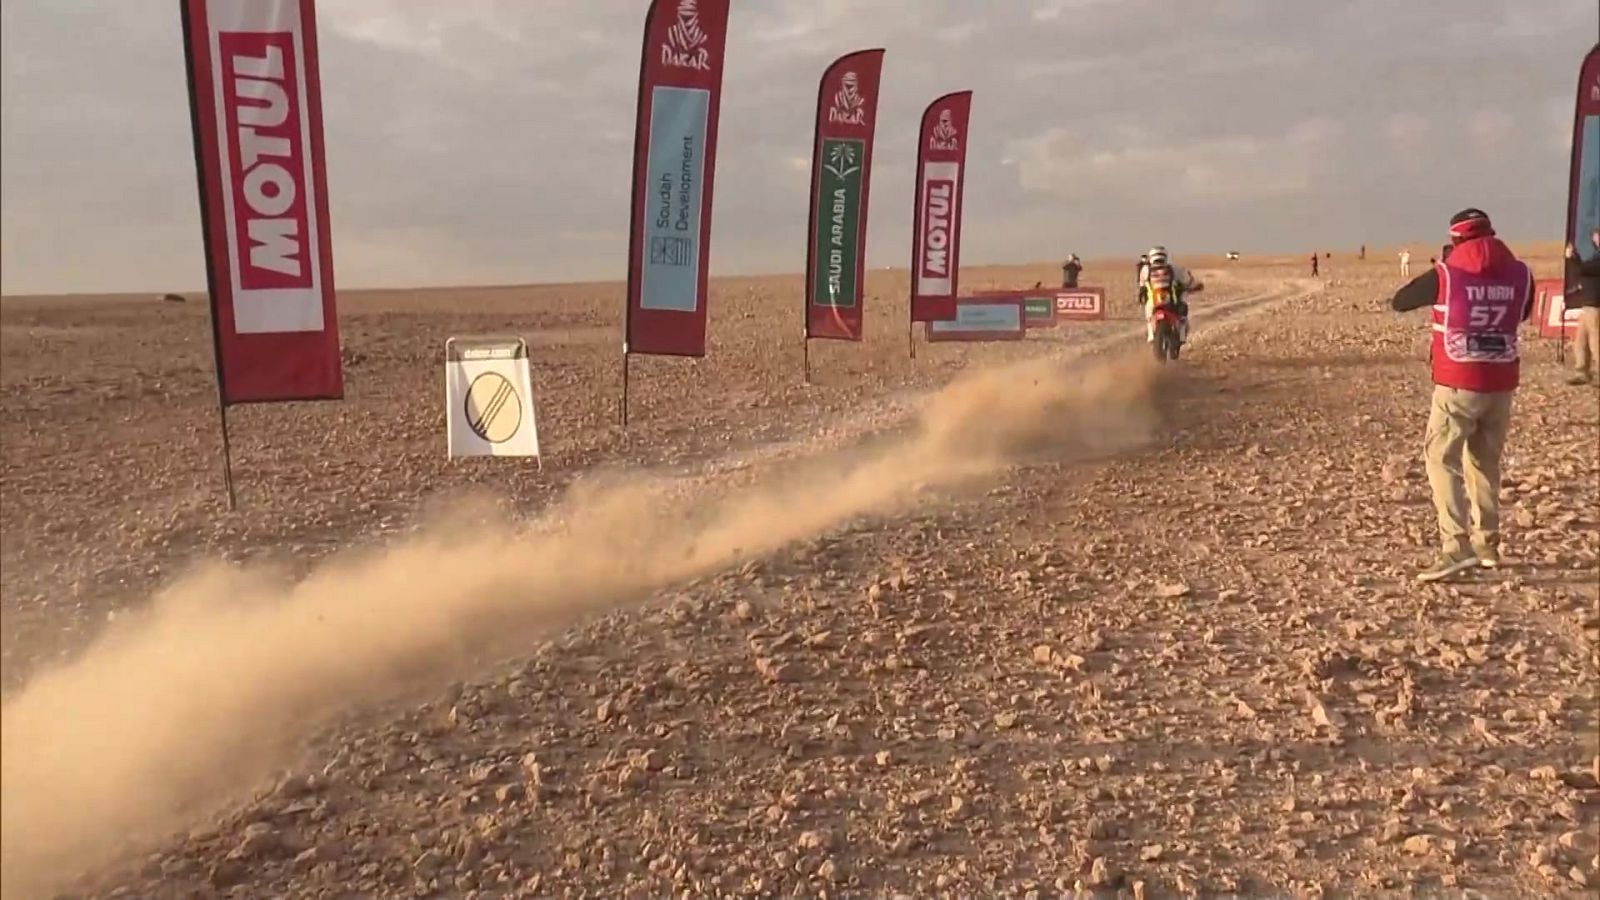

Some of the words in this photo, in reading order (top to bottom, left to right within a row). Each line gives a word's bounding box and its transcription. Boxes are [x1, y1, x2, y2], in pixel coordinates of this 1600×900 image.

[661, 43, 710, 70] DAKAR
[829, 106, 865, 126] DAKAR
[232, 45, 302, 277] MOTUL
[930, 136, 958, 150] DAKAR
[656, 172, 671, 229] Soudah
[675, 135, 693, 231] Development
[831, 188, 846, 246] ARABIA
[926, 184, 950, 274] MOTUL
[829, 249, 842, 294] SAUDI
[1057, 298, 1093, 308] OTUL
[1465, 286, 1485, 300] TV
[1470, 306, 1507, 325] 57
